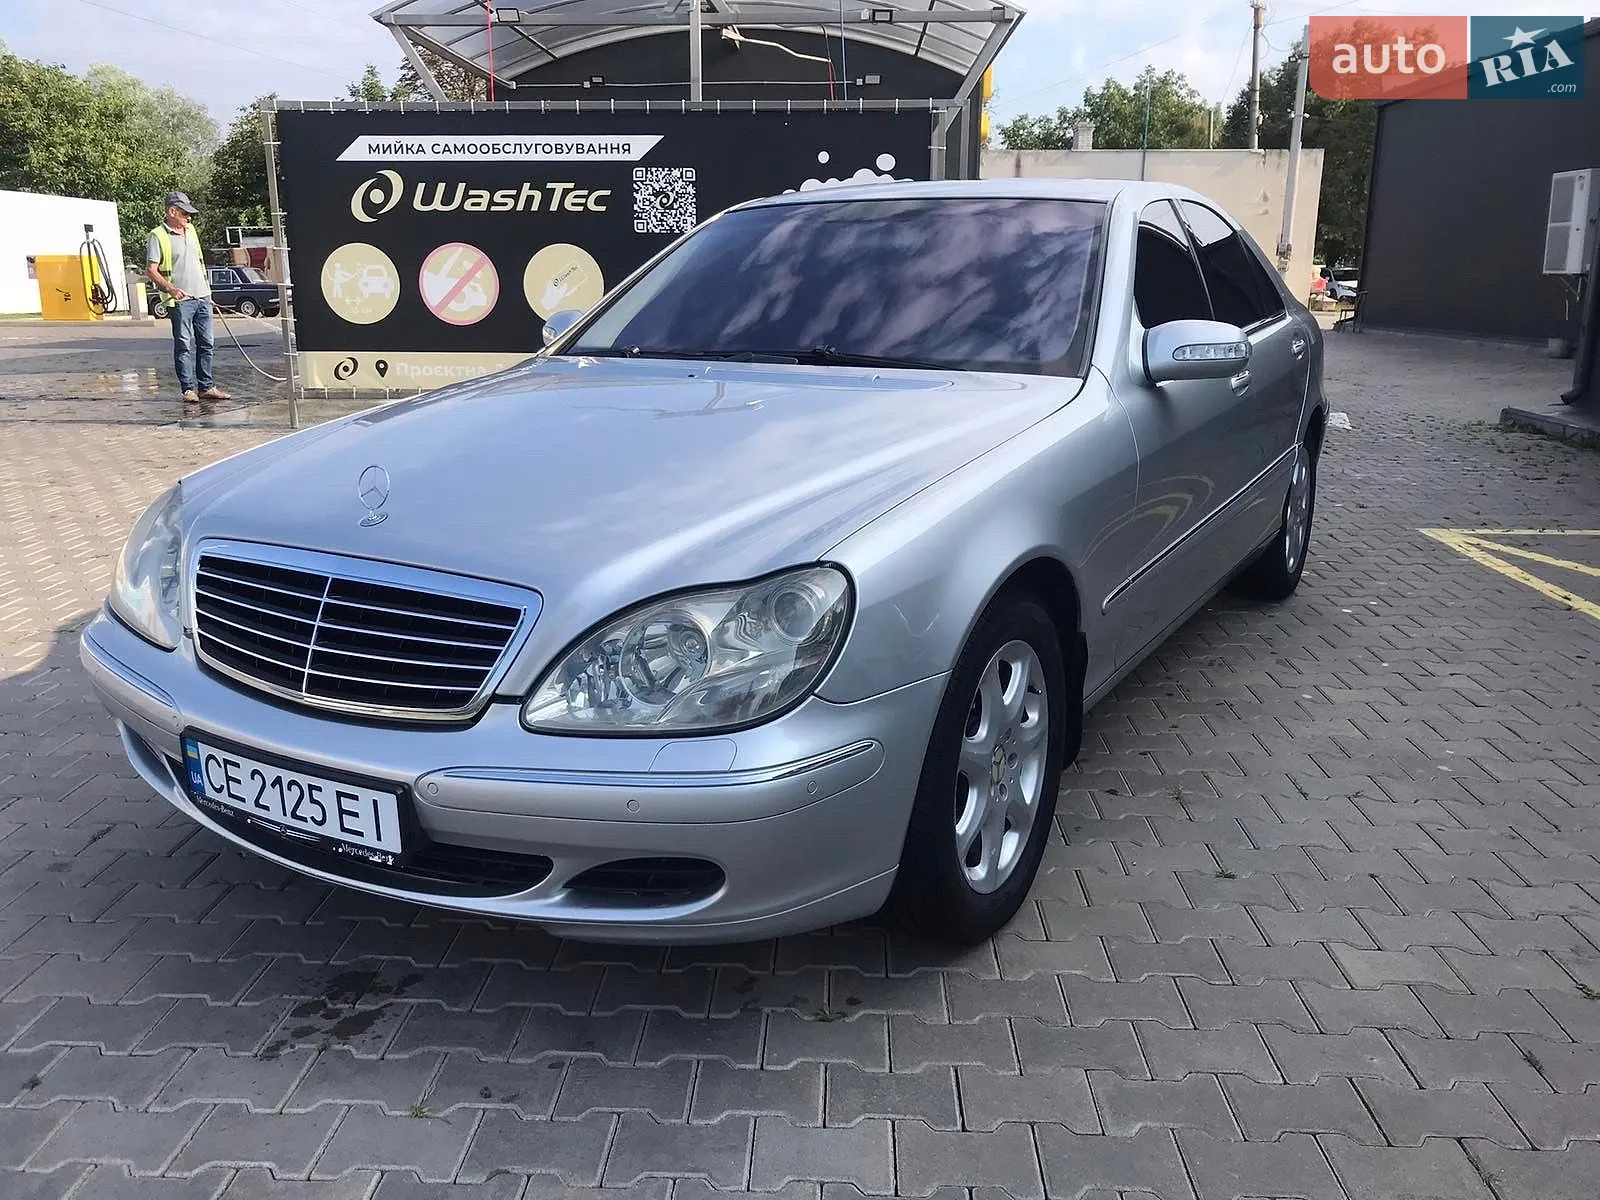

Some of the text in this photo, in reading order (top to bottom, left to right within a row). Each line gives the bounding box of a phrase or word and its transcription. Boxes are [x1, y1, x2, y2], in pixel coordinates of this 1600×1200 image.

[367, 140, 632, 156] МИЙКА САМООБСЛУГОВУВАННЯ
[412, 181, 612, 212] WashTec
[190, 770, 204, 786] UA
[204, 752, 383, 842] CE 2125 EI
